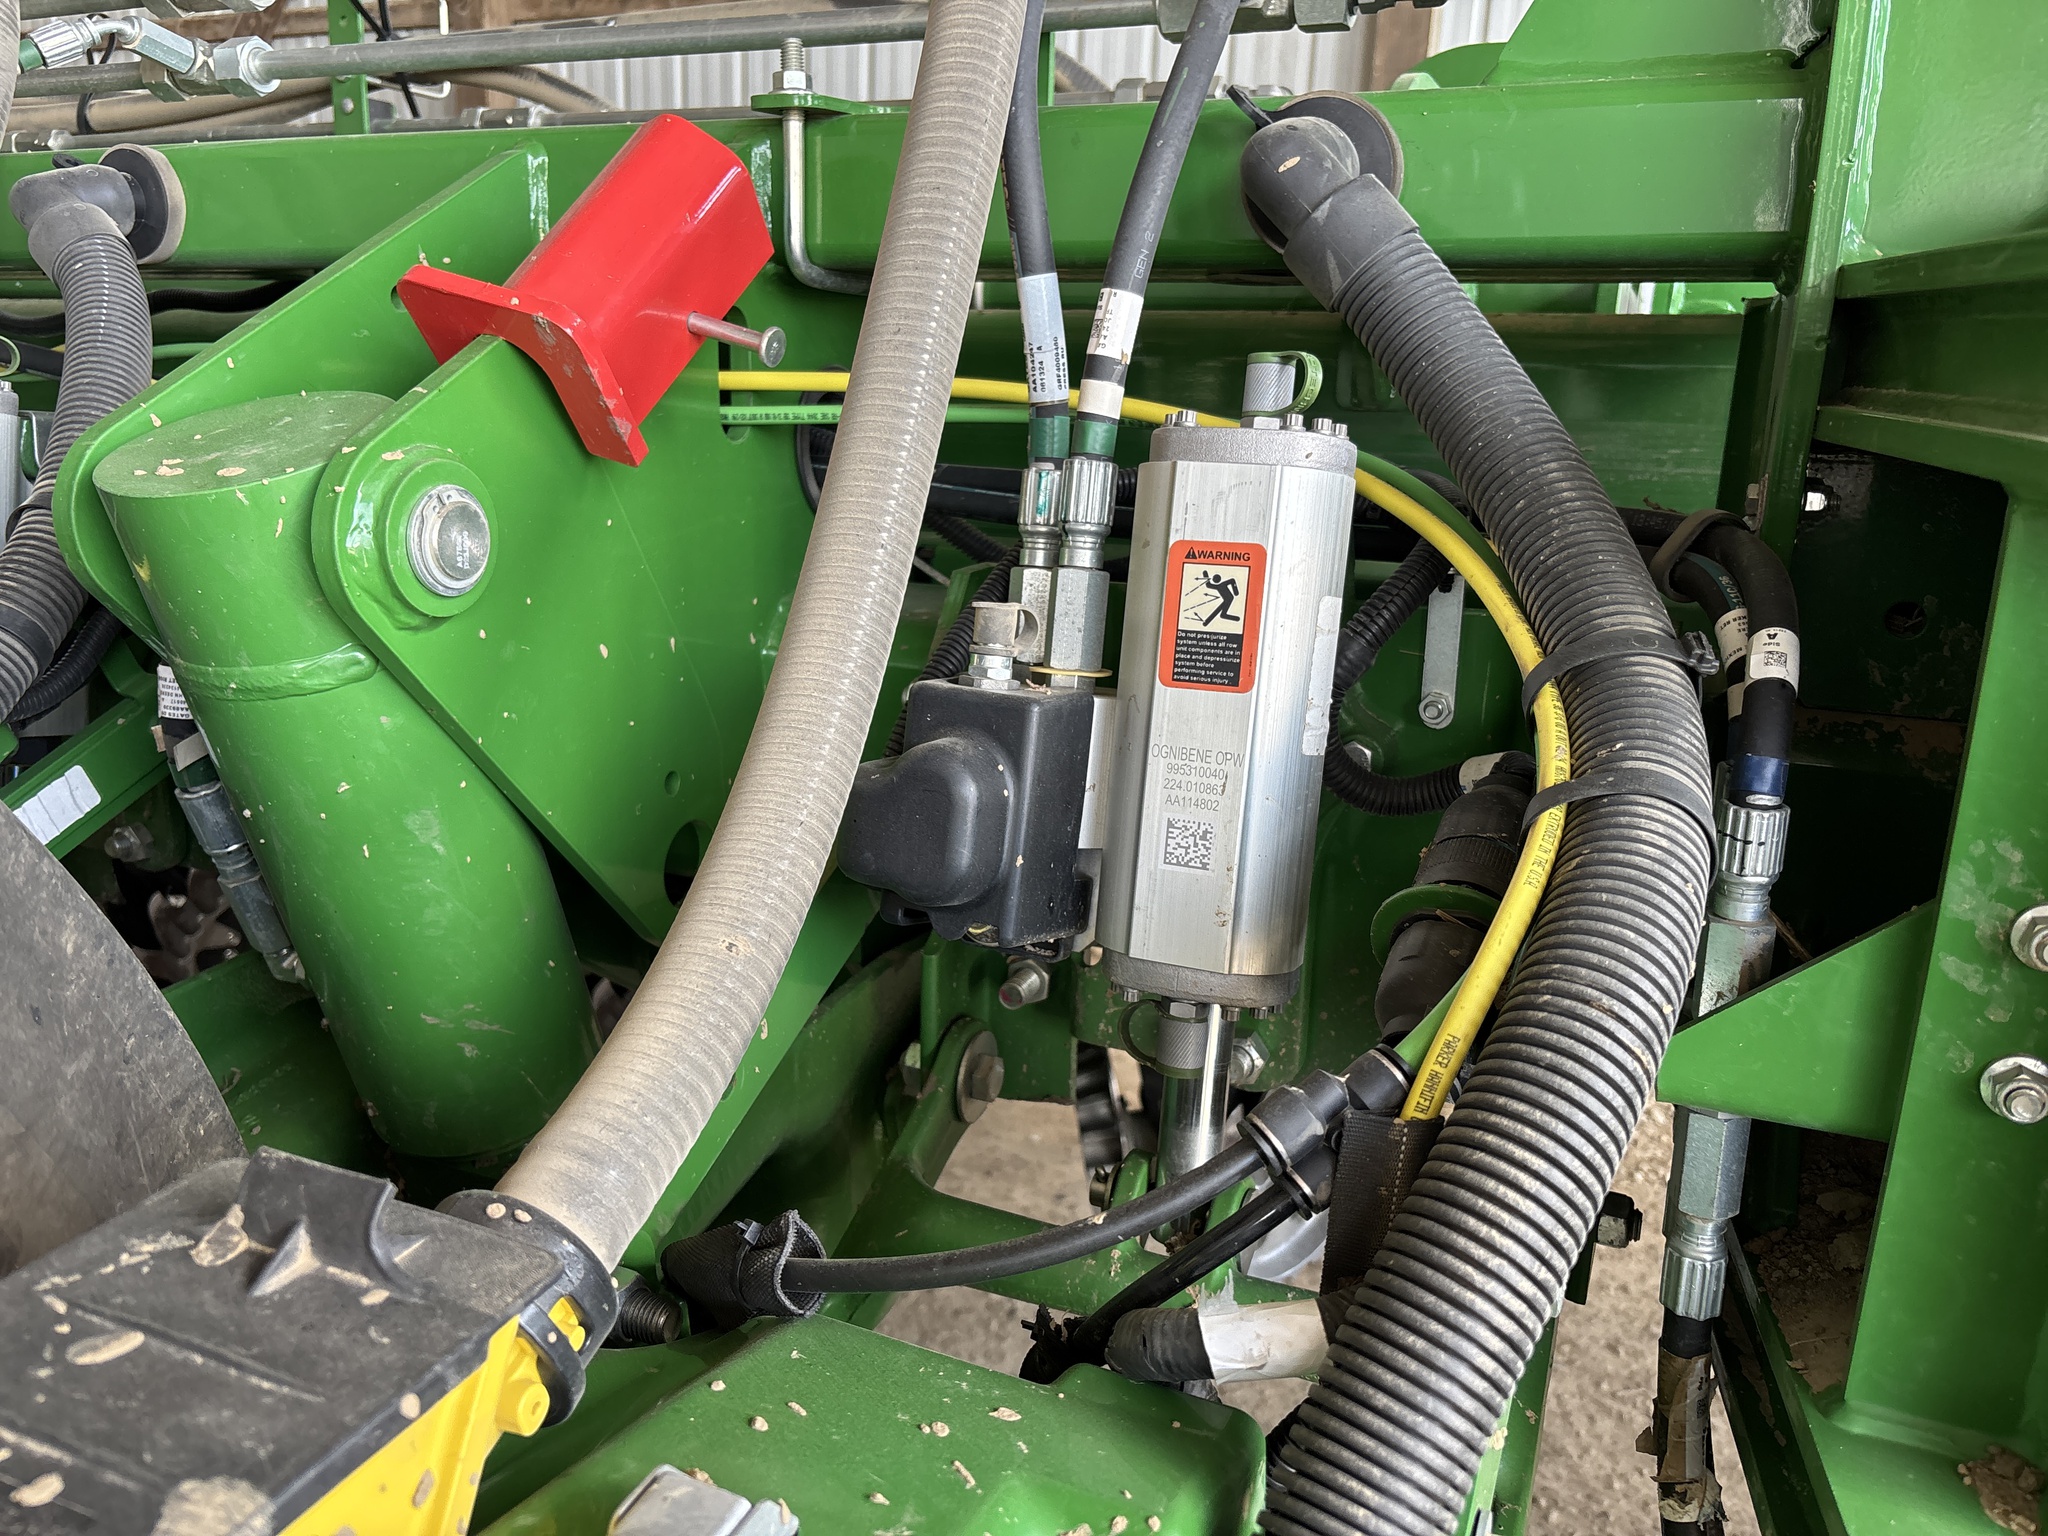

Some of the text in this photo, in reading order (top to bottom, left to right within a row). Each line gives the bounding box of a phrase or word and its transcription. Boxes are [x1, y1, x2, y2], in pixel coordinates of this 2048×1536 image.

[1134, 248, 1150, 279] GEN
[1144, 230, 1155, 243] 2
[1197, 549, 1251, 562] WARNING
[1188, 647, 1223, 655] components
[1203, 655, 1241, 663] depressurize
[1174, 667, 1205, 675] performing
[168, 711, 190, 719] GATES
[1151, 743, 1245, 768] OGNIBENE OPW
[1166, 762, 1225, 780] 995310040
[1163, 777, 1224, 796] 224.010863
[1164, 794, 1219, 811] AA114802
[1541, 811, 1562, 846] EXTRUDED
[1537, 843, 1551, 857] IN
[1531, 855, 1549, 872] THE
[1433, 1033, 1461, 1069] PARKER
[1414, 1069, 1445, 1116] HANNIFIN
